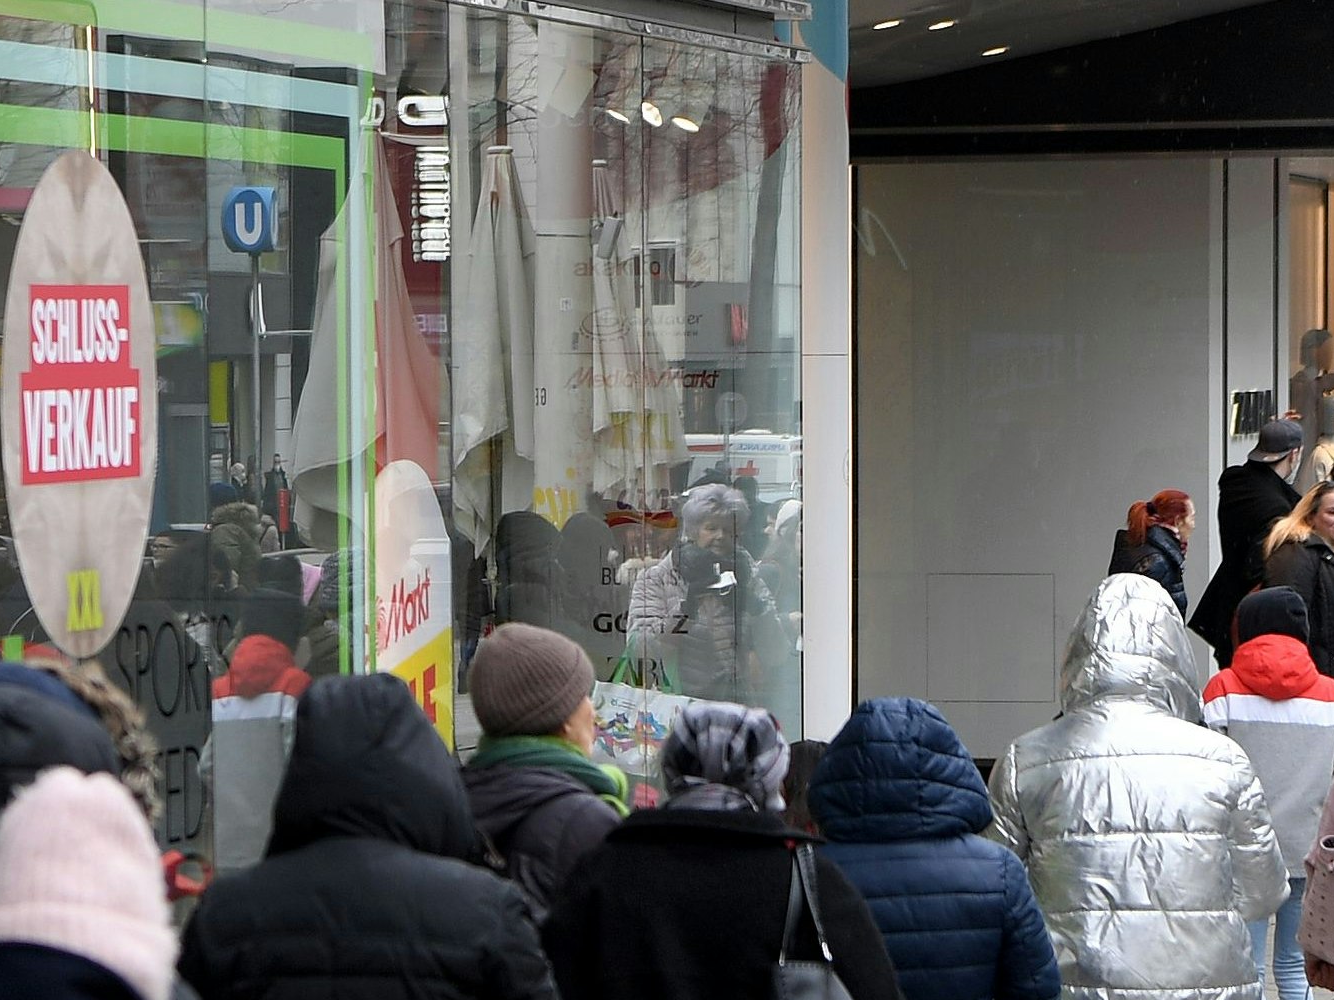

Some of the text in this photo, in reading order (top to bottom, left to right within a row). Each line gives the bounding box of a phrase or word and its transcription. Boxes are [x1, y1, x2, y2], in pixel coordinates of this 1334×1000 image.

[31, 298, 128, 364] SCHLUSS-
[23, 386, 138, 473] VERKAUF
[67, 569, 104, 632] XXL
